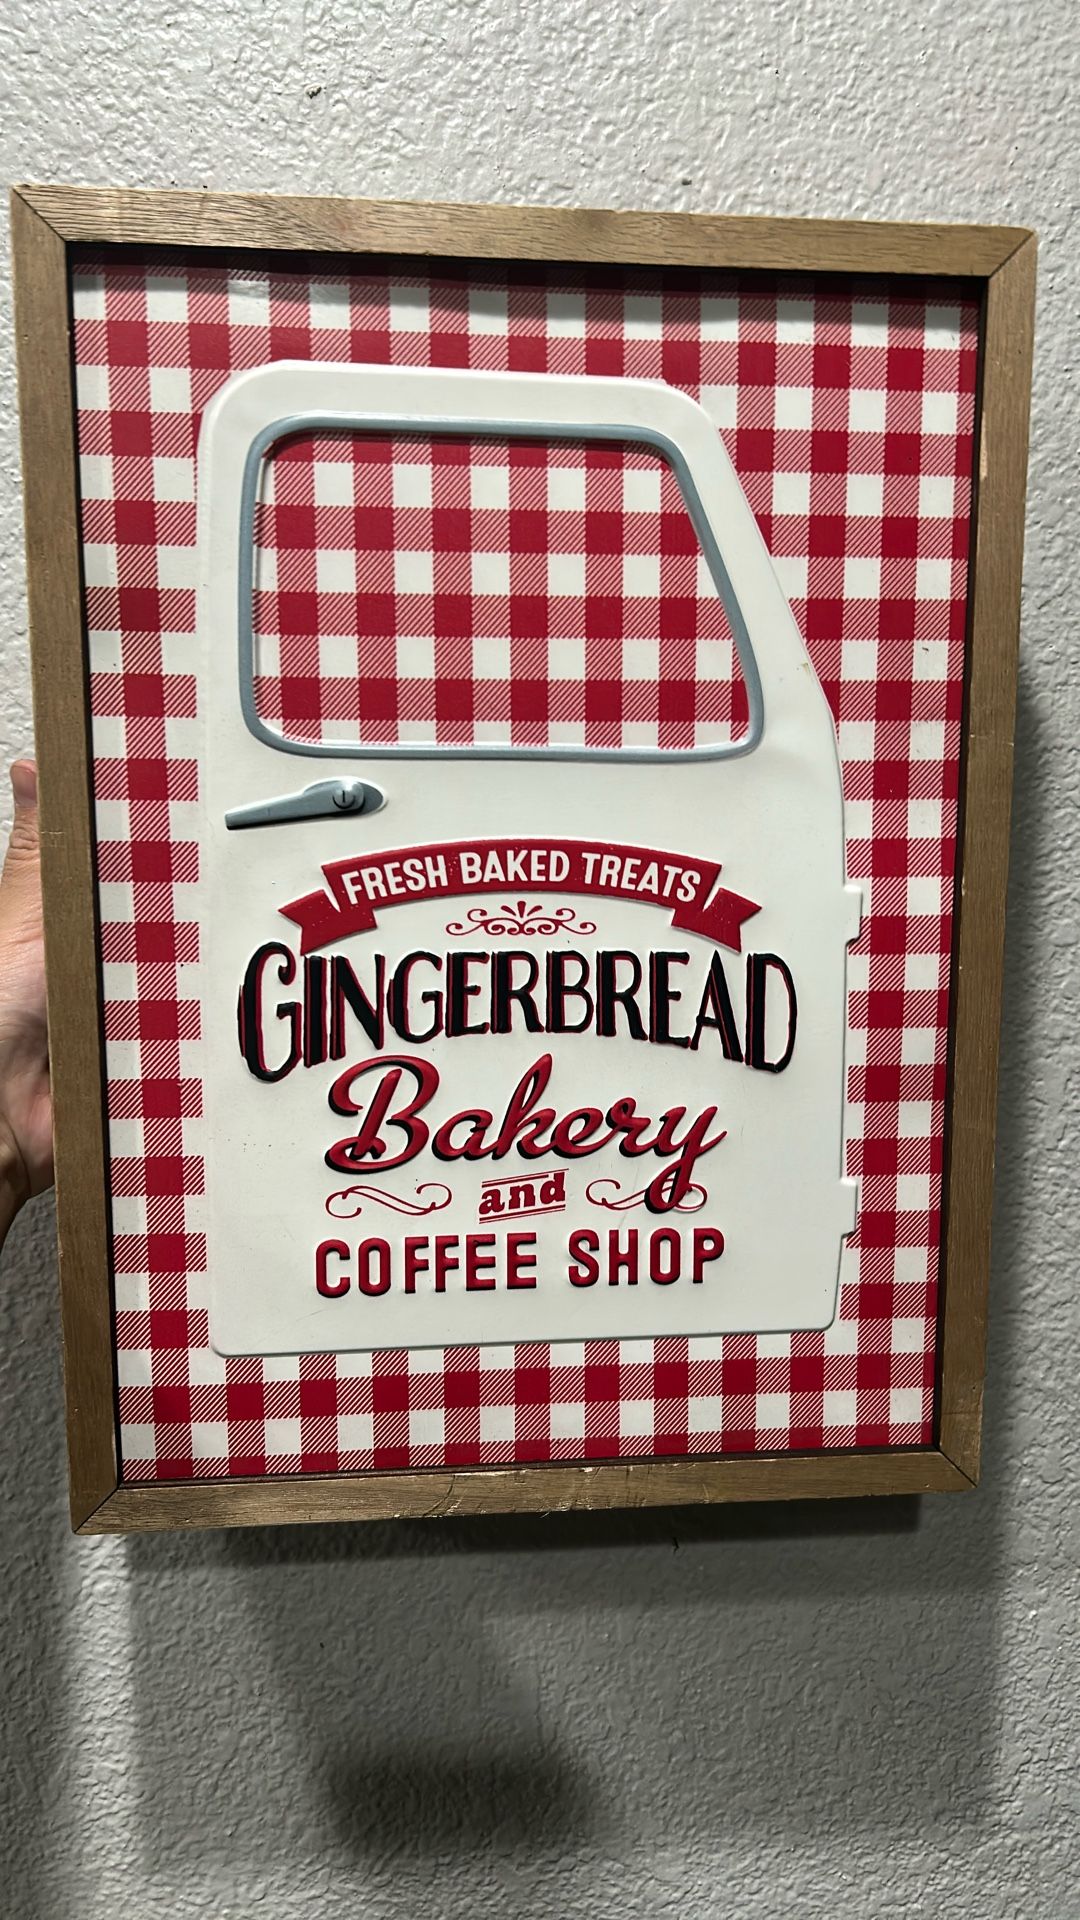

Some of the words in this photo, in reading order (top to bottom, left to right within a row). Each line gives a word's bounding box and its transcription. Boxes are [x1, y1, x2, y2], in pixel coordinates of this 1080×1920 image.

[341, 854, 448, 904] FRESH
[461, 849, 570, 884] BAKED
[582, 852, 702, 902] TREATS
[237, 941, 798, 1082] GINGERBREAD
[324, 1053, 728, 1214] Bakery
[478, 1171, 566, 1217] and
[315, 1232, 538, 1298] COFFEE
[567, 1227, 725, 1287] SHOP
